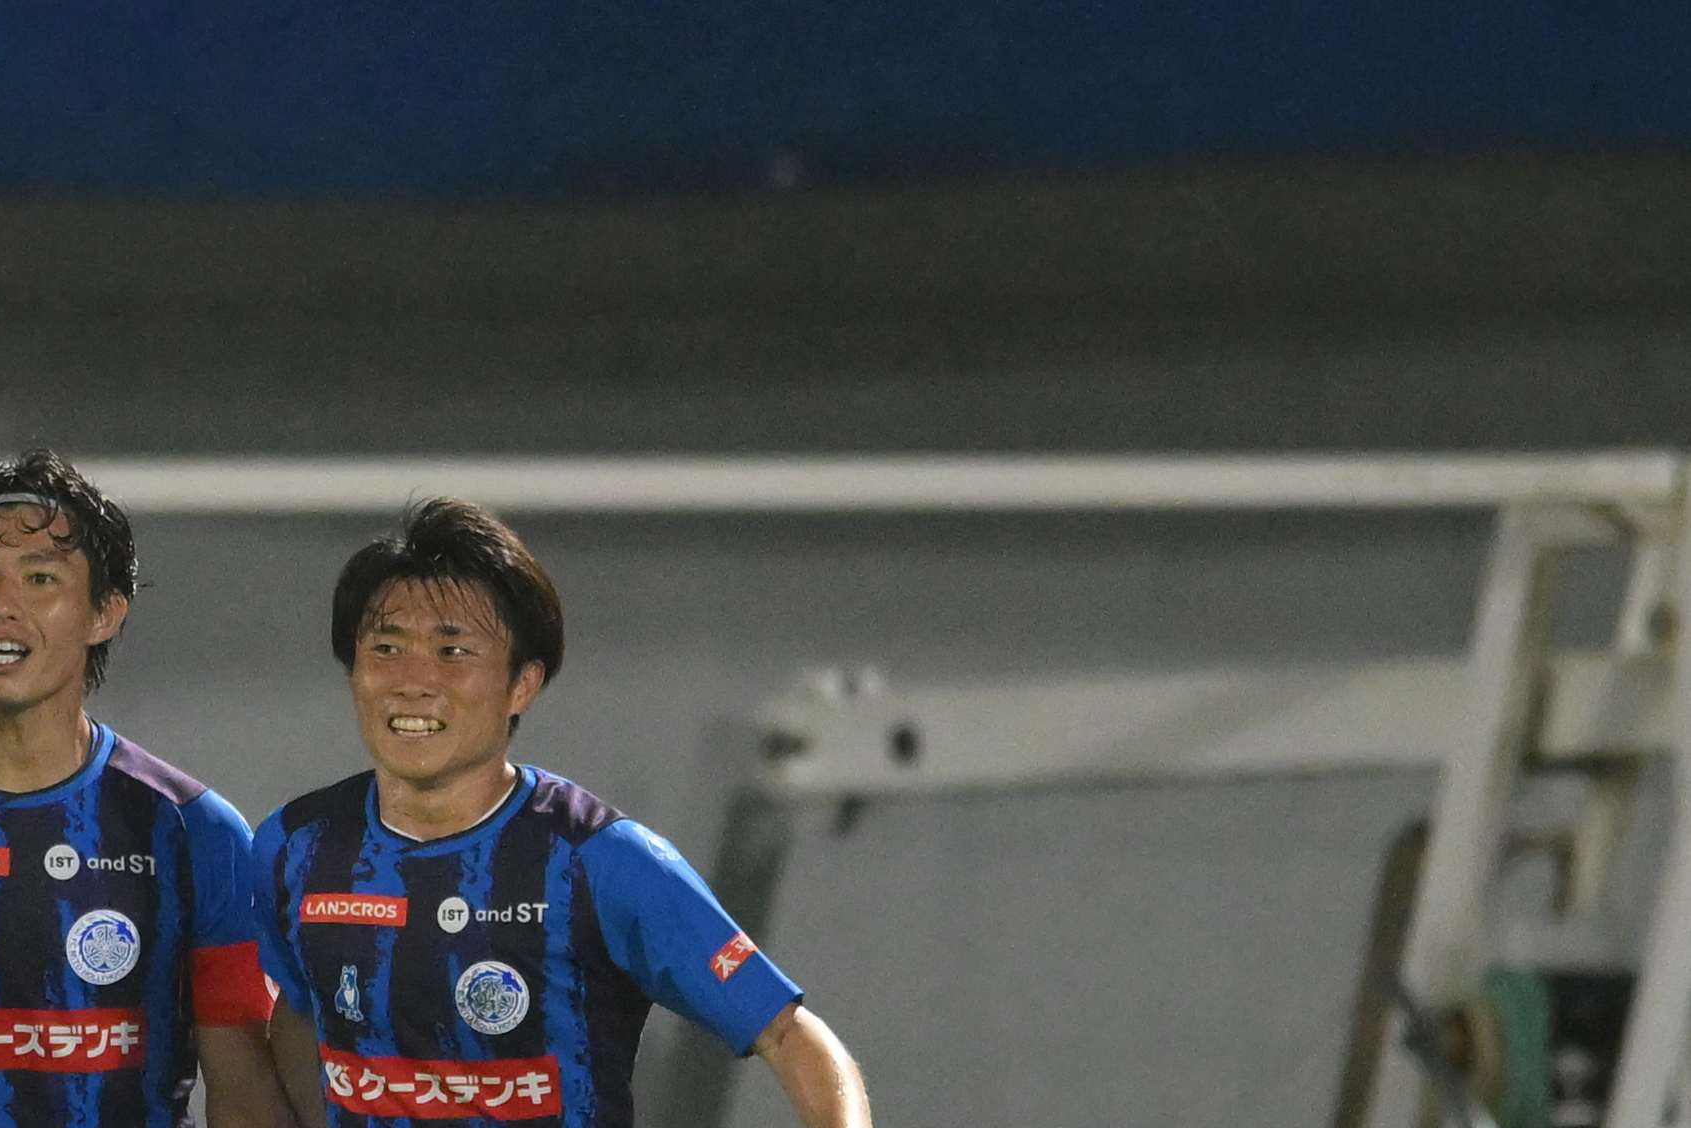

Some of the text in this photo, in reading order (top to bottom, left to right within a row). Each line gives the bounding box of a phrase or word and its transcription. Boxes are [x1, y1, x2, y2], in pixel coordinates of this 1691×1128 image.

[87, 856, 125, 872] and
[306, 902, 397, 919] LANDCROS
[475, 906, 512, 922] and
[517, 903, 549, 923] ST
[359, 1068, 551, 1107] ケーズデンキ
